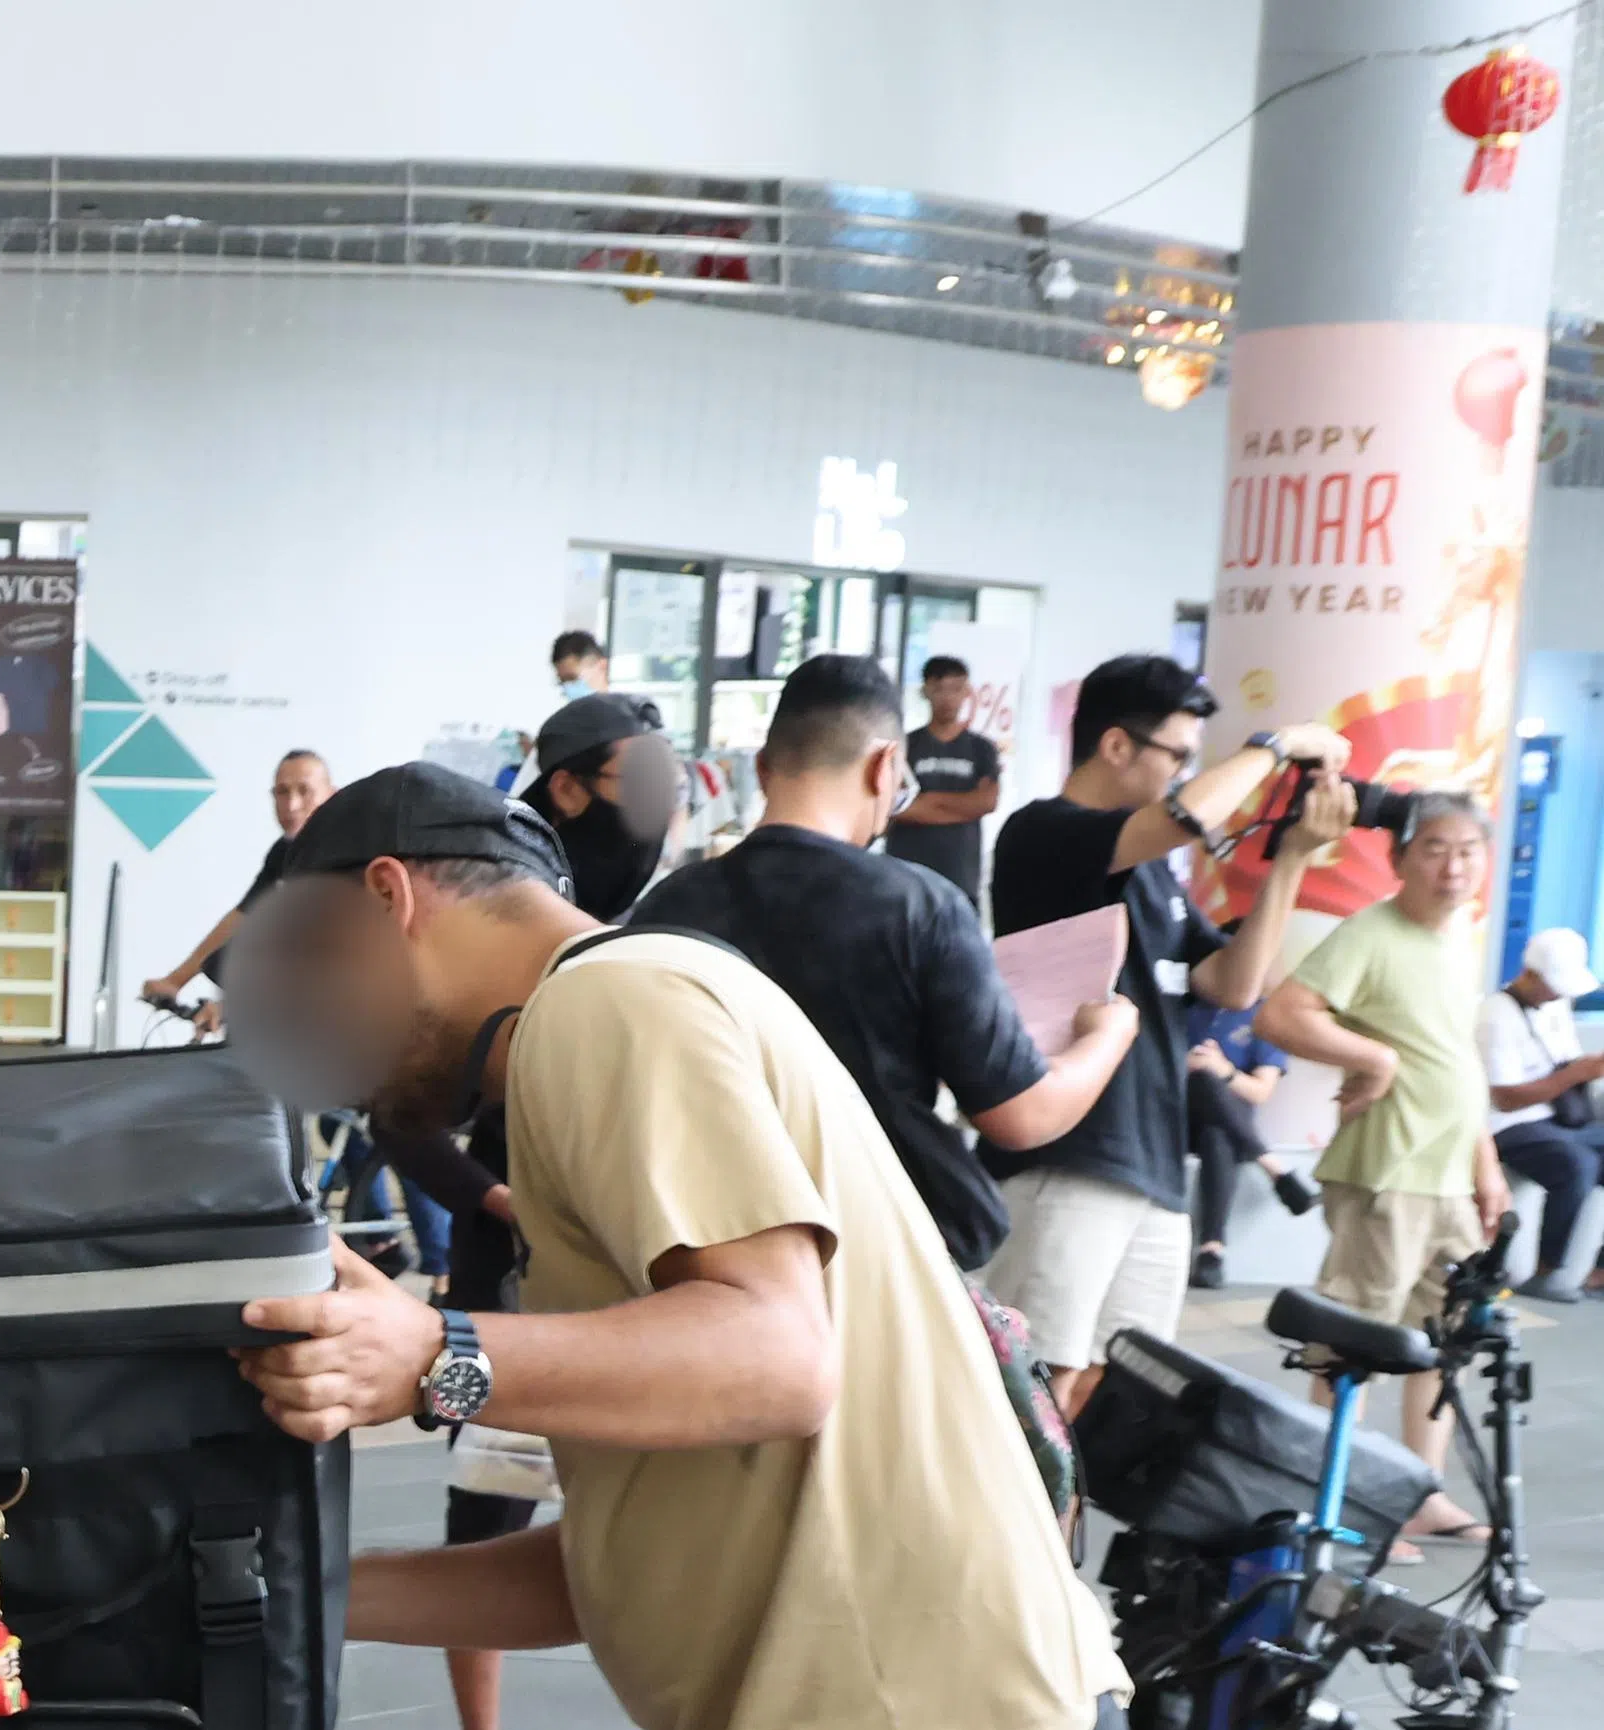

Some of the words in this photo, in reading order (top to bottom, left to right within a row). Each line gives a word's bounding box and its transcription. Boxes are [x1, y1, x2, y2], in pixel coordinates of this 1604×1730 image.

[1243, 423, 1377, 457] HAPPY
[1224, 471, 1400, 568] LUNAR
[1288, 584, 1405, 614] YEAR
